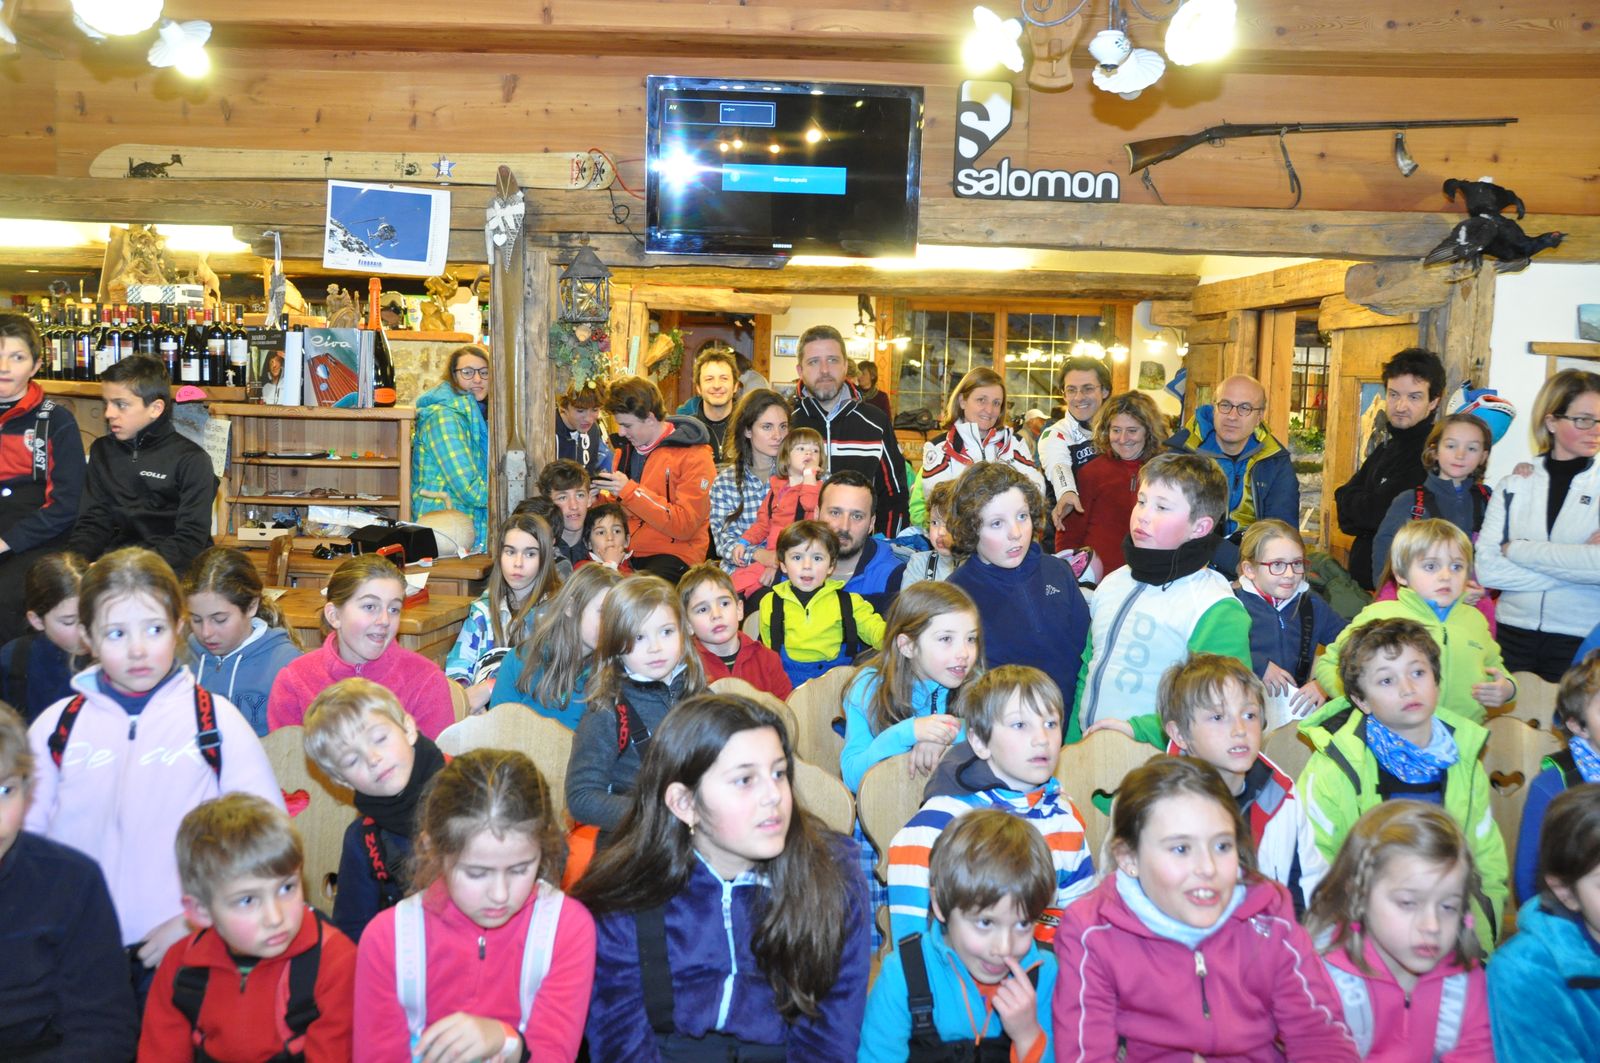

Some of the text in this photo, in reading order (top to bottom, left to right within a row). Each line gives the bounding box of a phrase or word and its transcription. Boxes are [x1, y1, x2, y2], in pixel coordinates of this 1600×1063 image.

[956, 158, 1119, 199] salomon
[35, 447, 46, 471] AST
[1114, 610, 1156, 694] poc
